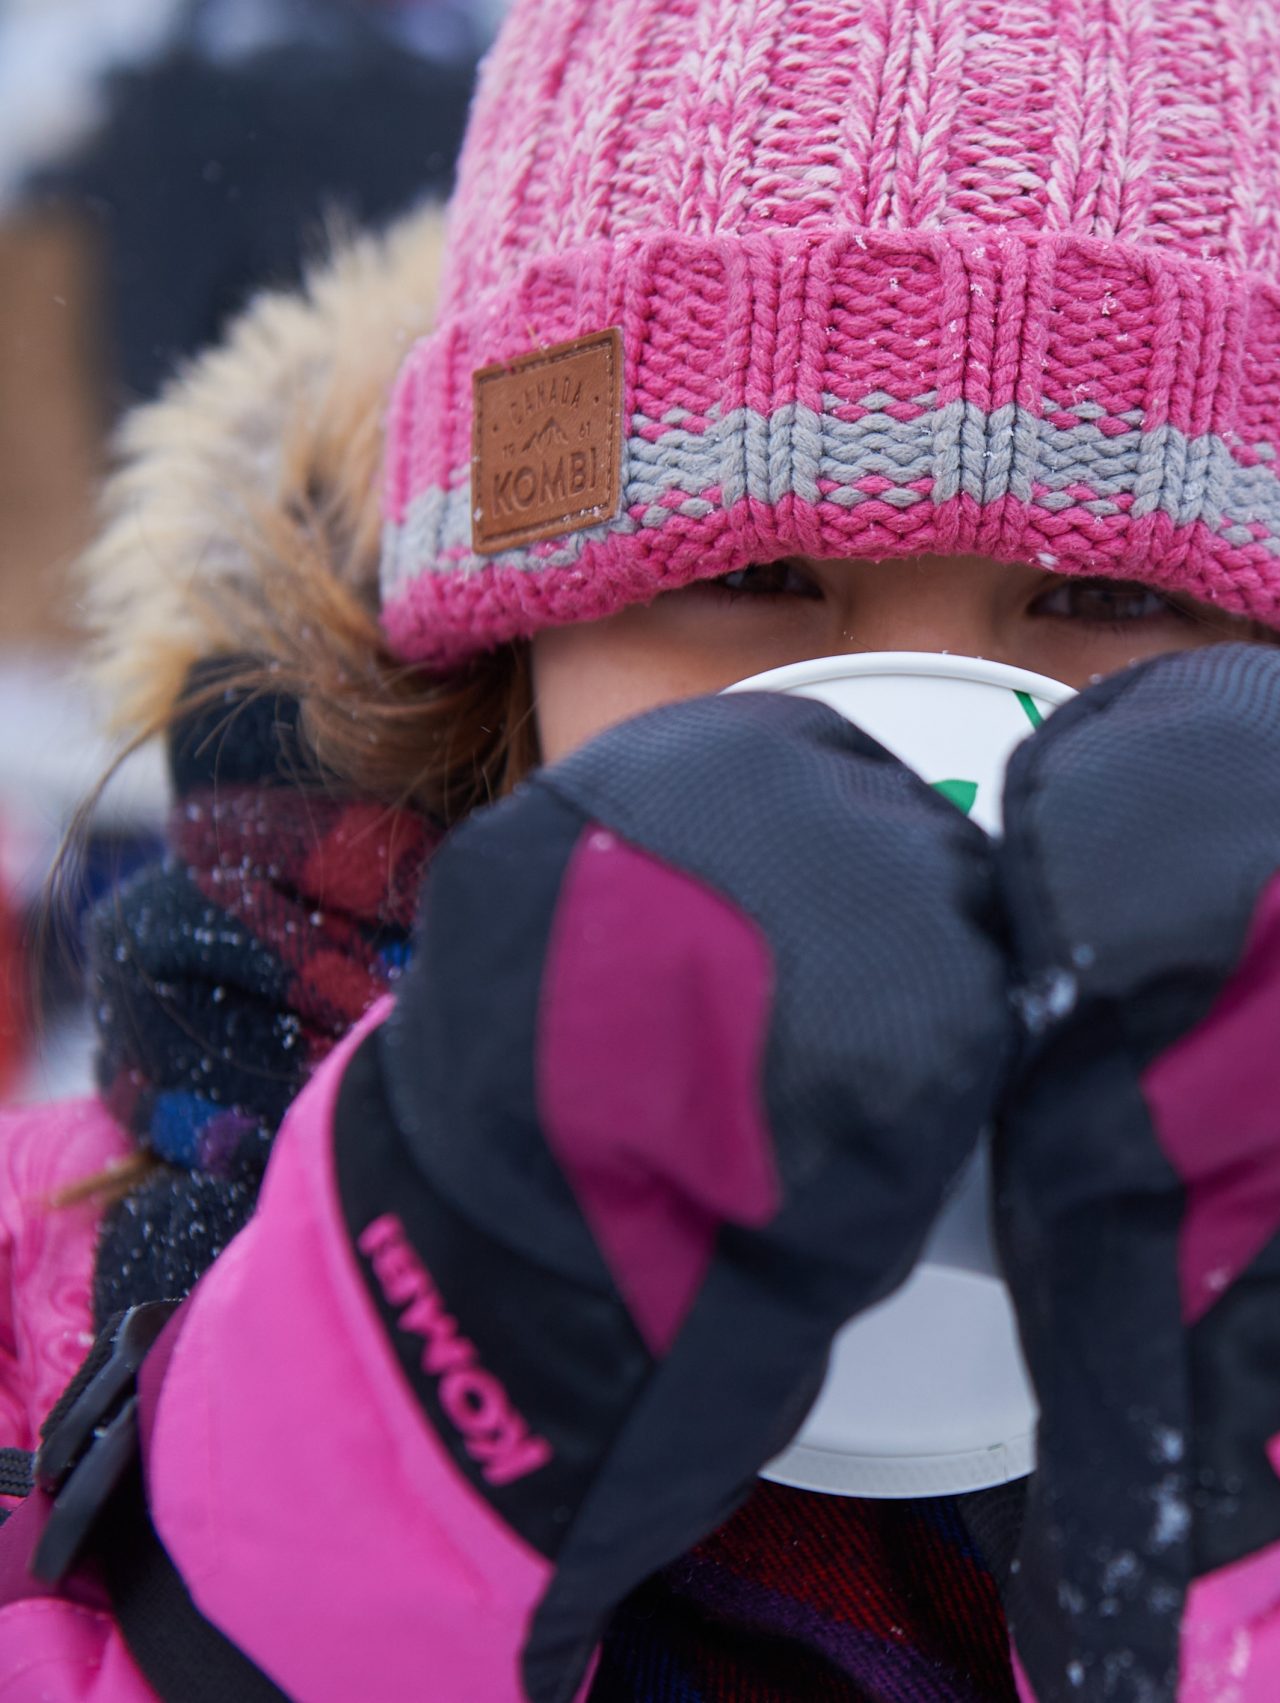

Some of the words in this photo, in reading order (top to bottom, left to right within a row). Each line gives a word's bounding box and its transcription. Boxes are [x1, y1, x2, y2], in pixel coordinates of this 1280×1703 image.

[509, 375, 583, 427] CANADA
[491, 447, 598, 518] KOMBI
[358, 1212, 553, 1487] KOMBI
